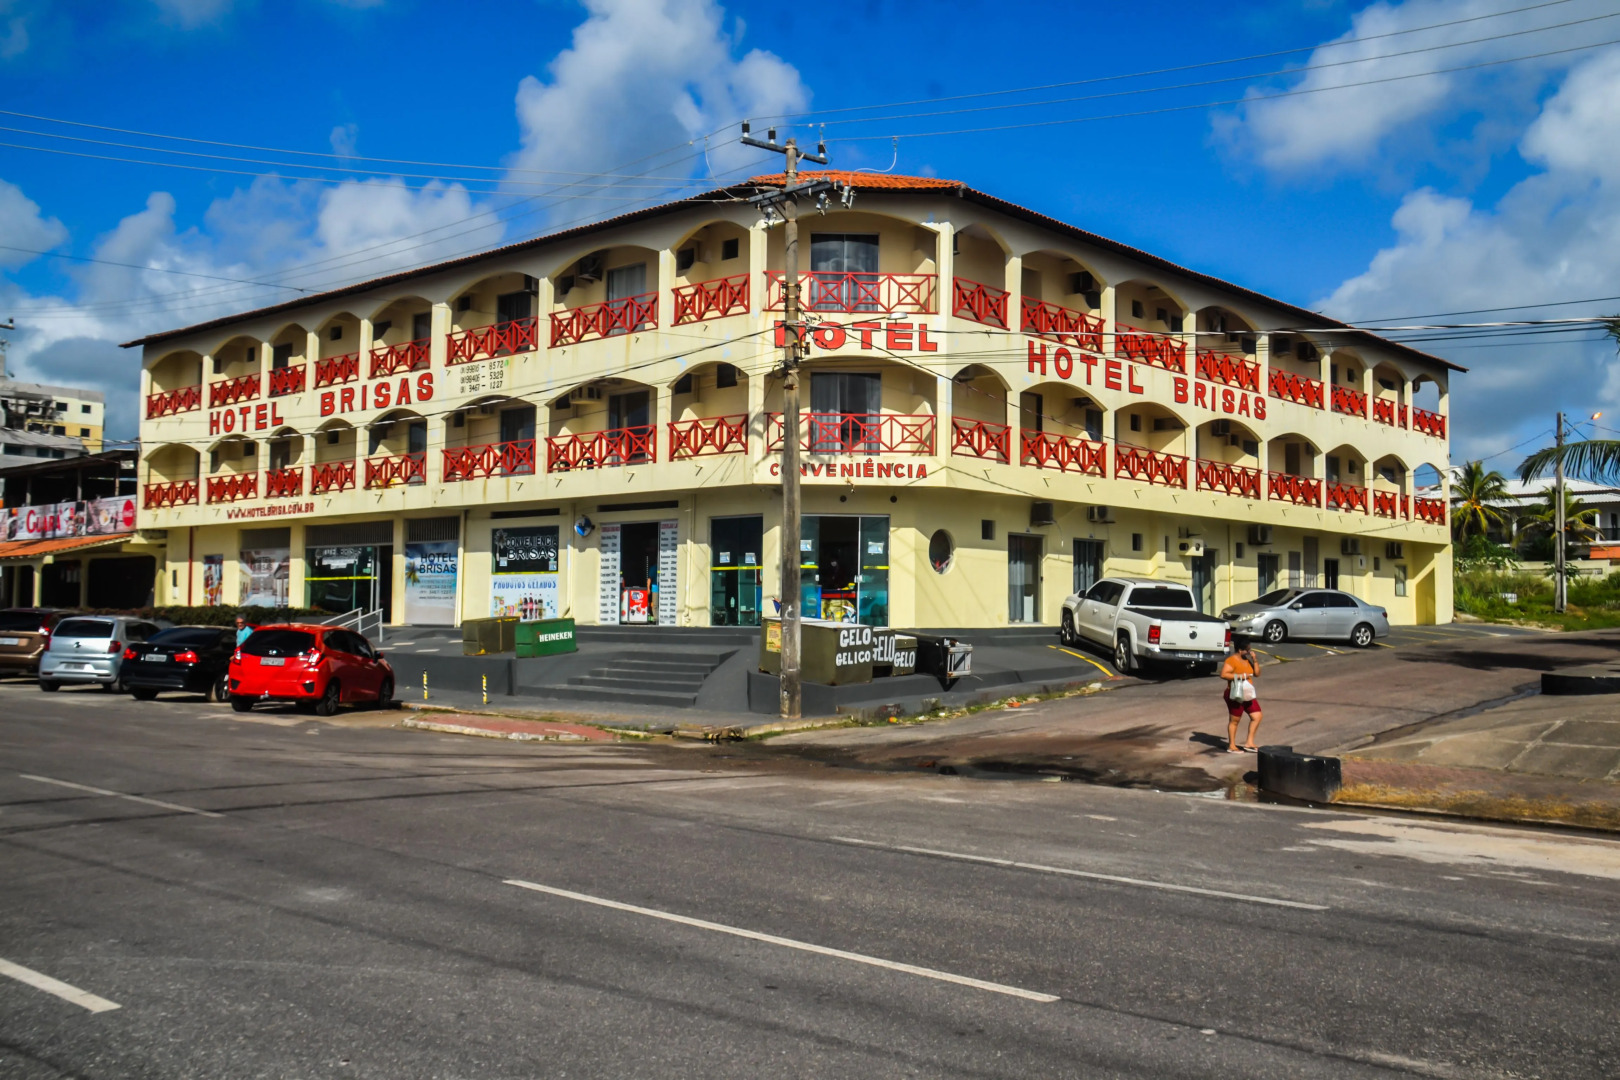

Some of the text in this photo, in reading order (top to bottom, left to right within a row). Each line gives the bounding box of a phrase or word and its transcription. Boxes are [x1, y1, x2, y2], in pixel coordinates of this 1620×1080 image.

[1028, 340, 1267, 420] HOTEL BRISAS
[209, 372, 434, 436] HOTEL BRISAS
[769, 457, 928, 479] CNVENIÊNCIA
[420, 552, 455, 563] HOTEL
[506, 547, 557, 561] BRISAS
[419, 564, 457, 573] BRISAS
[539, 631, 573, 642] HEINEKEN
[840, 628, 872, 648] GELO
[836, 650, 871, 666] GELICO
[893, 651, 916, 668] GELO
